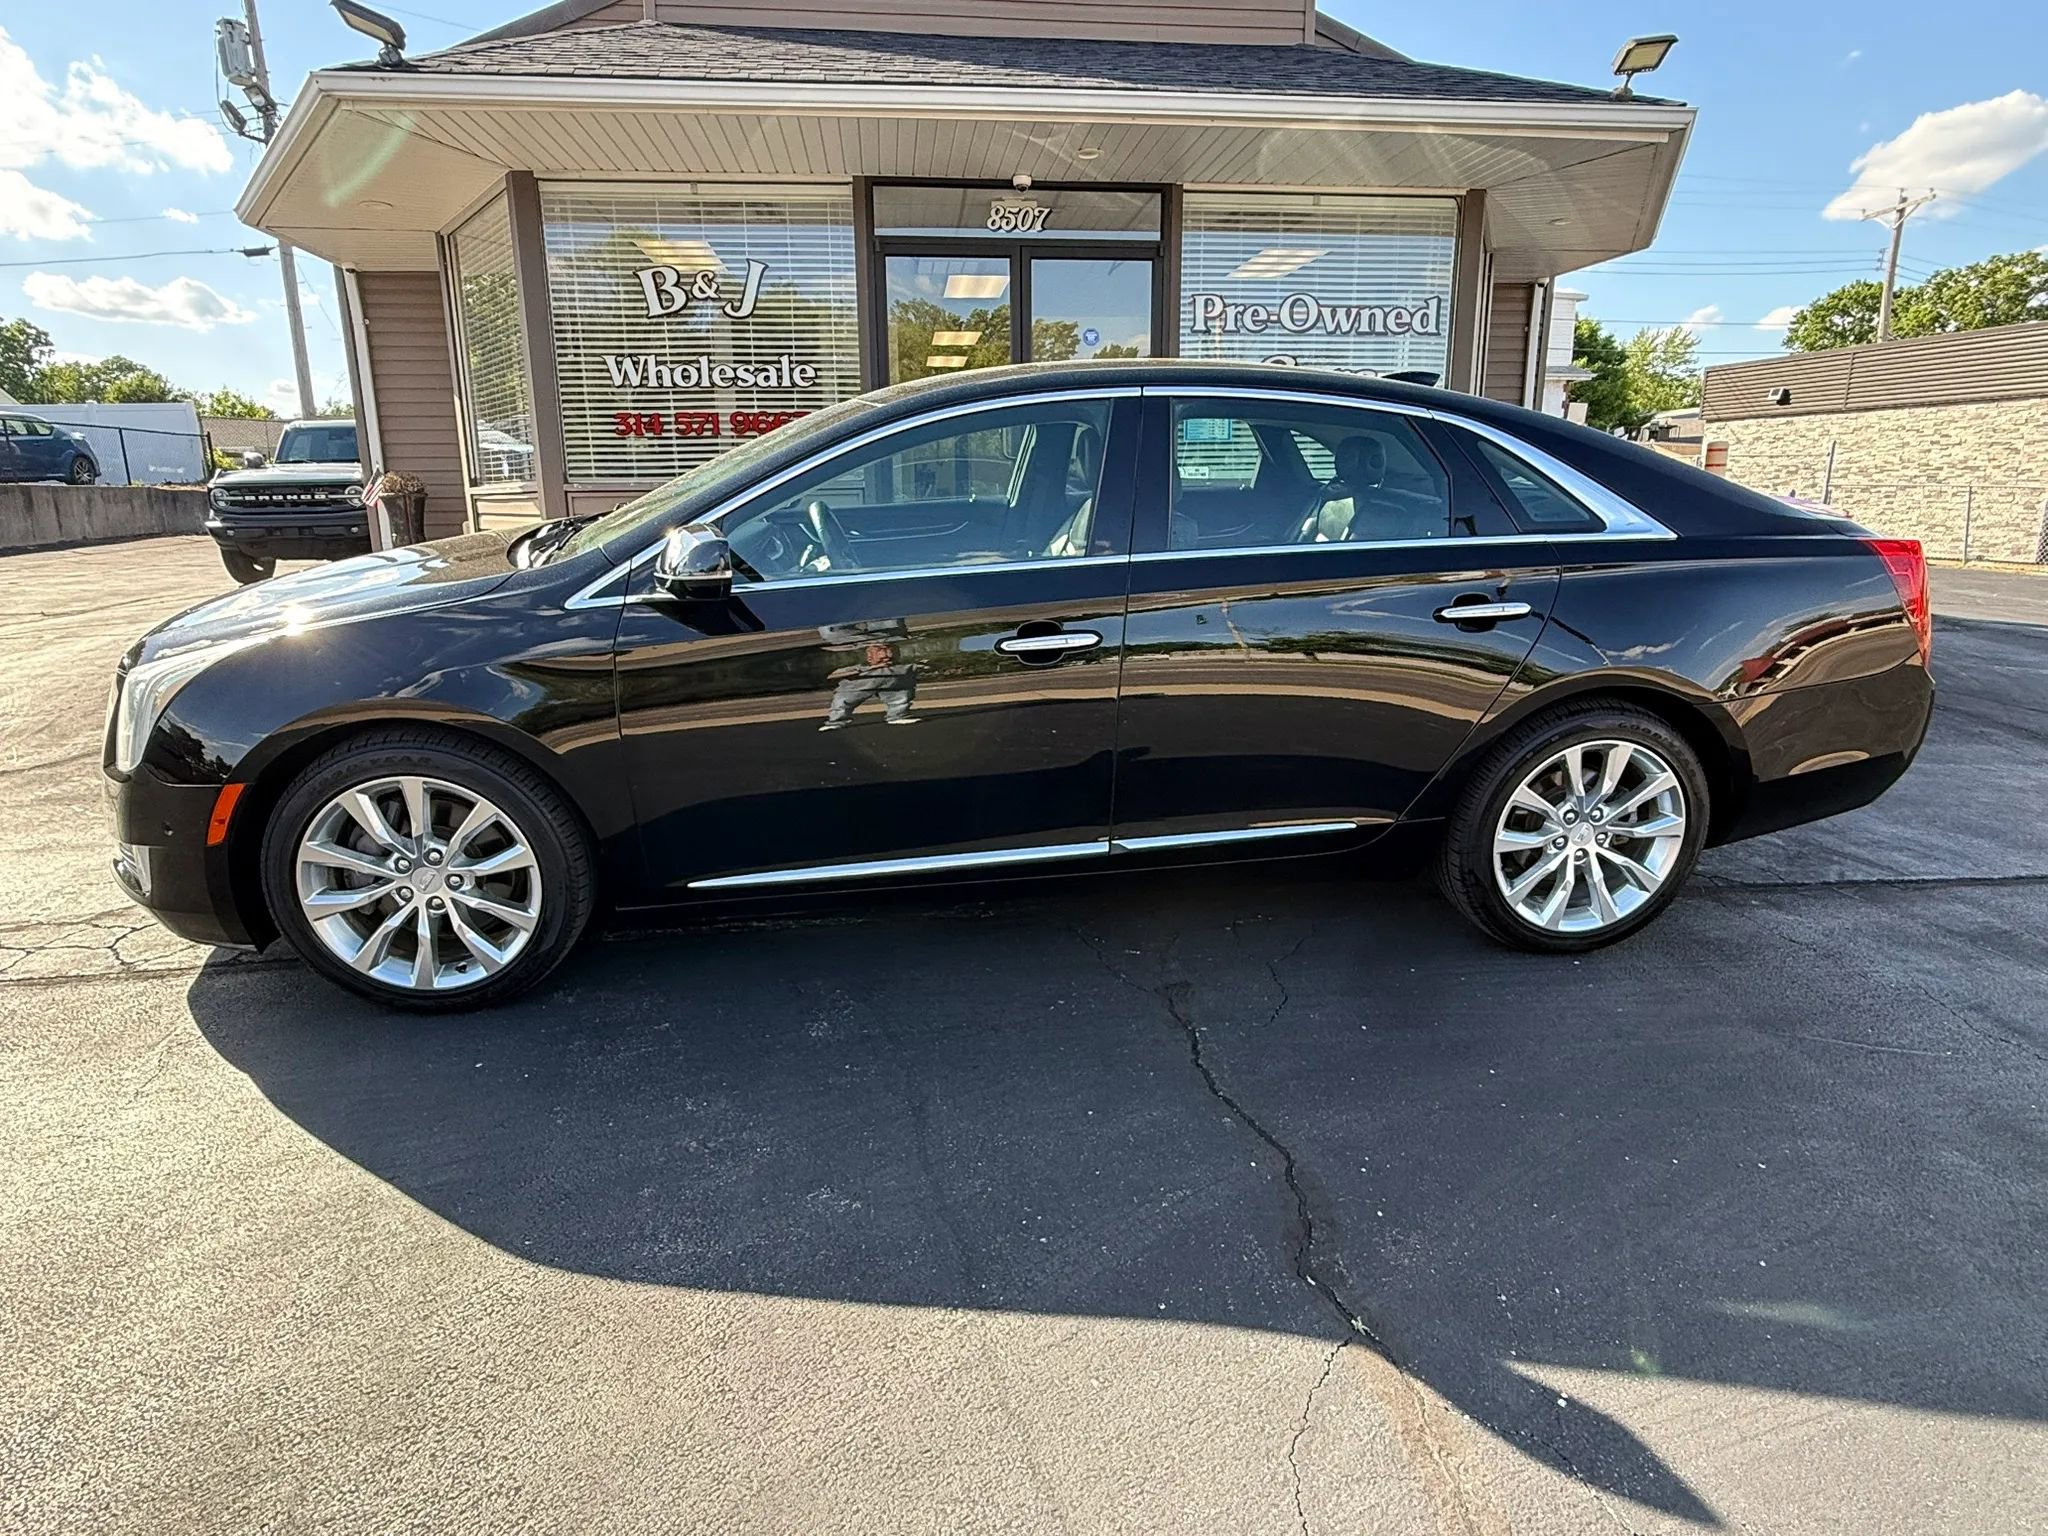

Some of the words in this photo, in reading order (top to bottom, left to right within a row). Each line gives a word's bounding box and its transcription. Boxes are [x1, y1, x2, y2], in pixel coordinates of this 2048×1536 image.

[986, 204, 1053, 233] 8507
[632, 265, 690, 319] B
[691, 270, 720, 300] &
[722, 258, 769, 319] J
[1190, 293, 1442, 336] Pre-Owned
[601, 354, 817, 389] Wholesale
[614, 412, 664, 436] 314
[674, 411, 721, 436] 571
